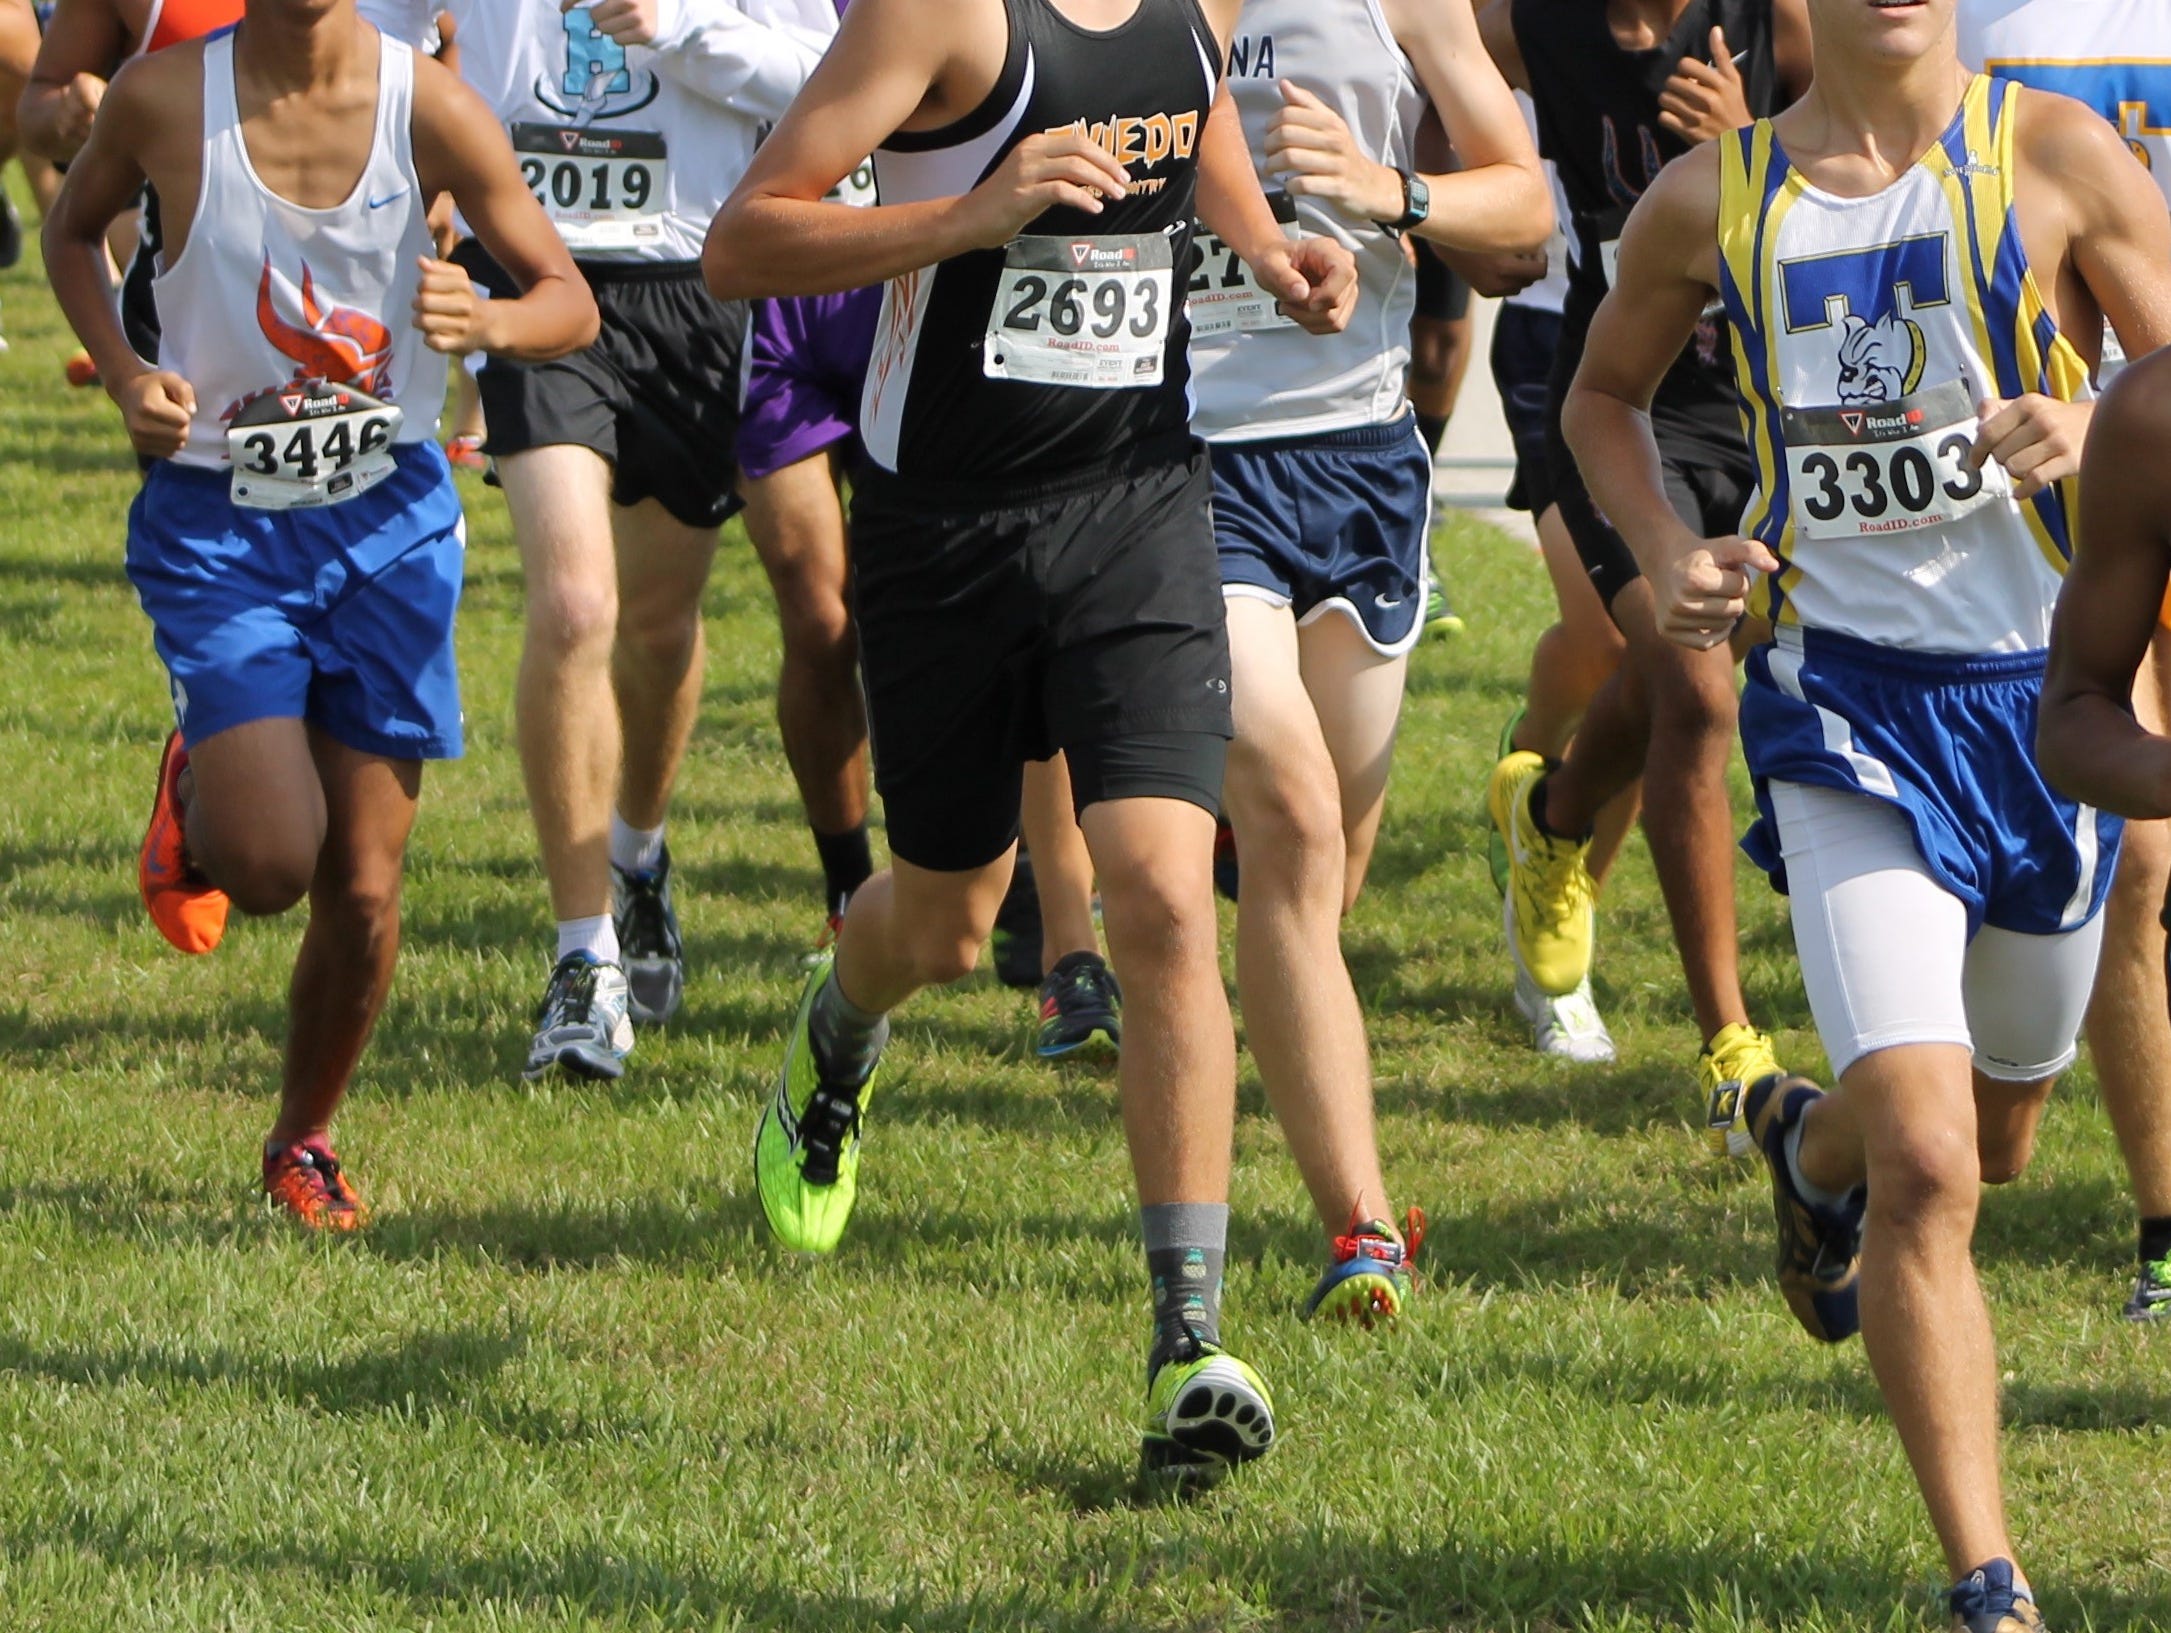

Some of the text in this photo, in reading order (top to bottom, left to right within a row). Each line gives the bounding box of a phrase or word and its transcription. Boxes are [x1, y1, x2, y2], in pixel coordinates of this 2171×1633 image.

[1226, 36, 1274, 79] NA
[521, 158, 652, 209] 2019
[1188, 238, 1246, 291] 27
[1003, 275, 1159, 338] 2693
[1189, 291, 1254, 307] oadID.com
[1047, 338, 1120, 352] RoadID.com
[243, 416, 391, 478] 3446
[1802, 433, 1983, 520] 3303
[1859, 513, 1943, 533] RoadID.com
